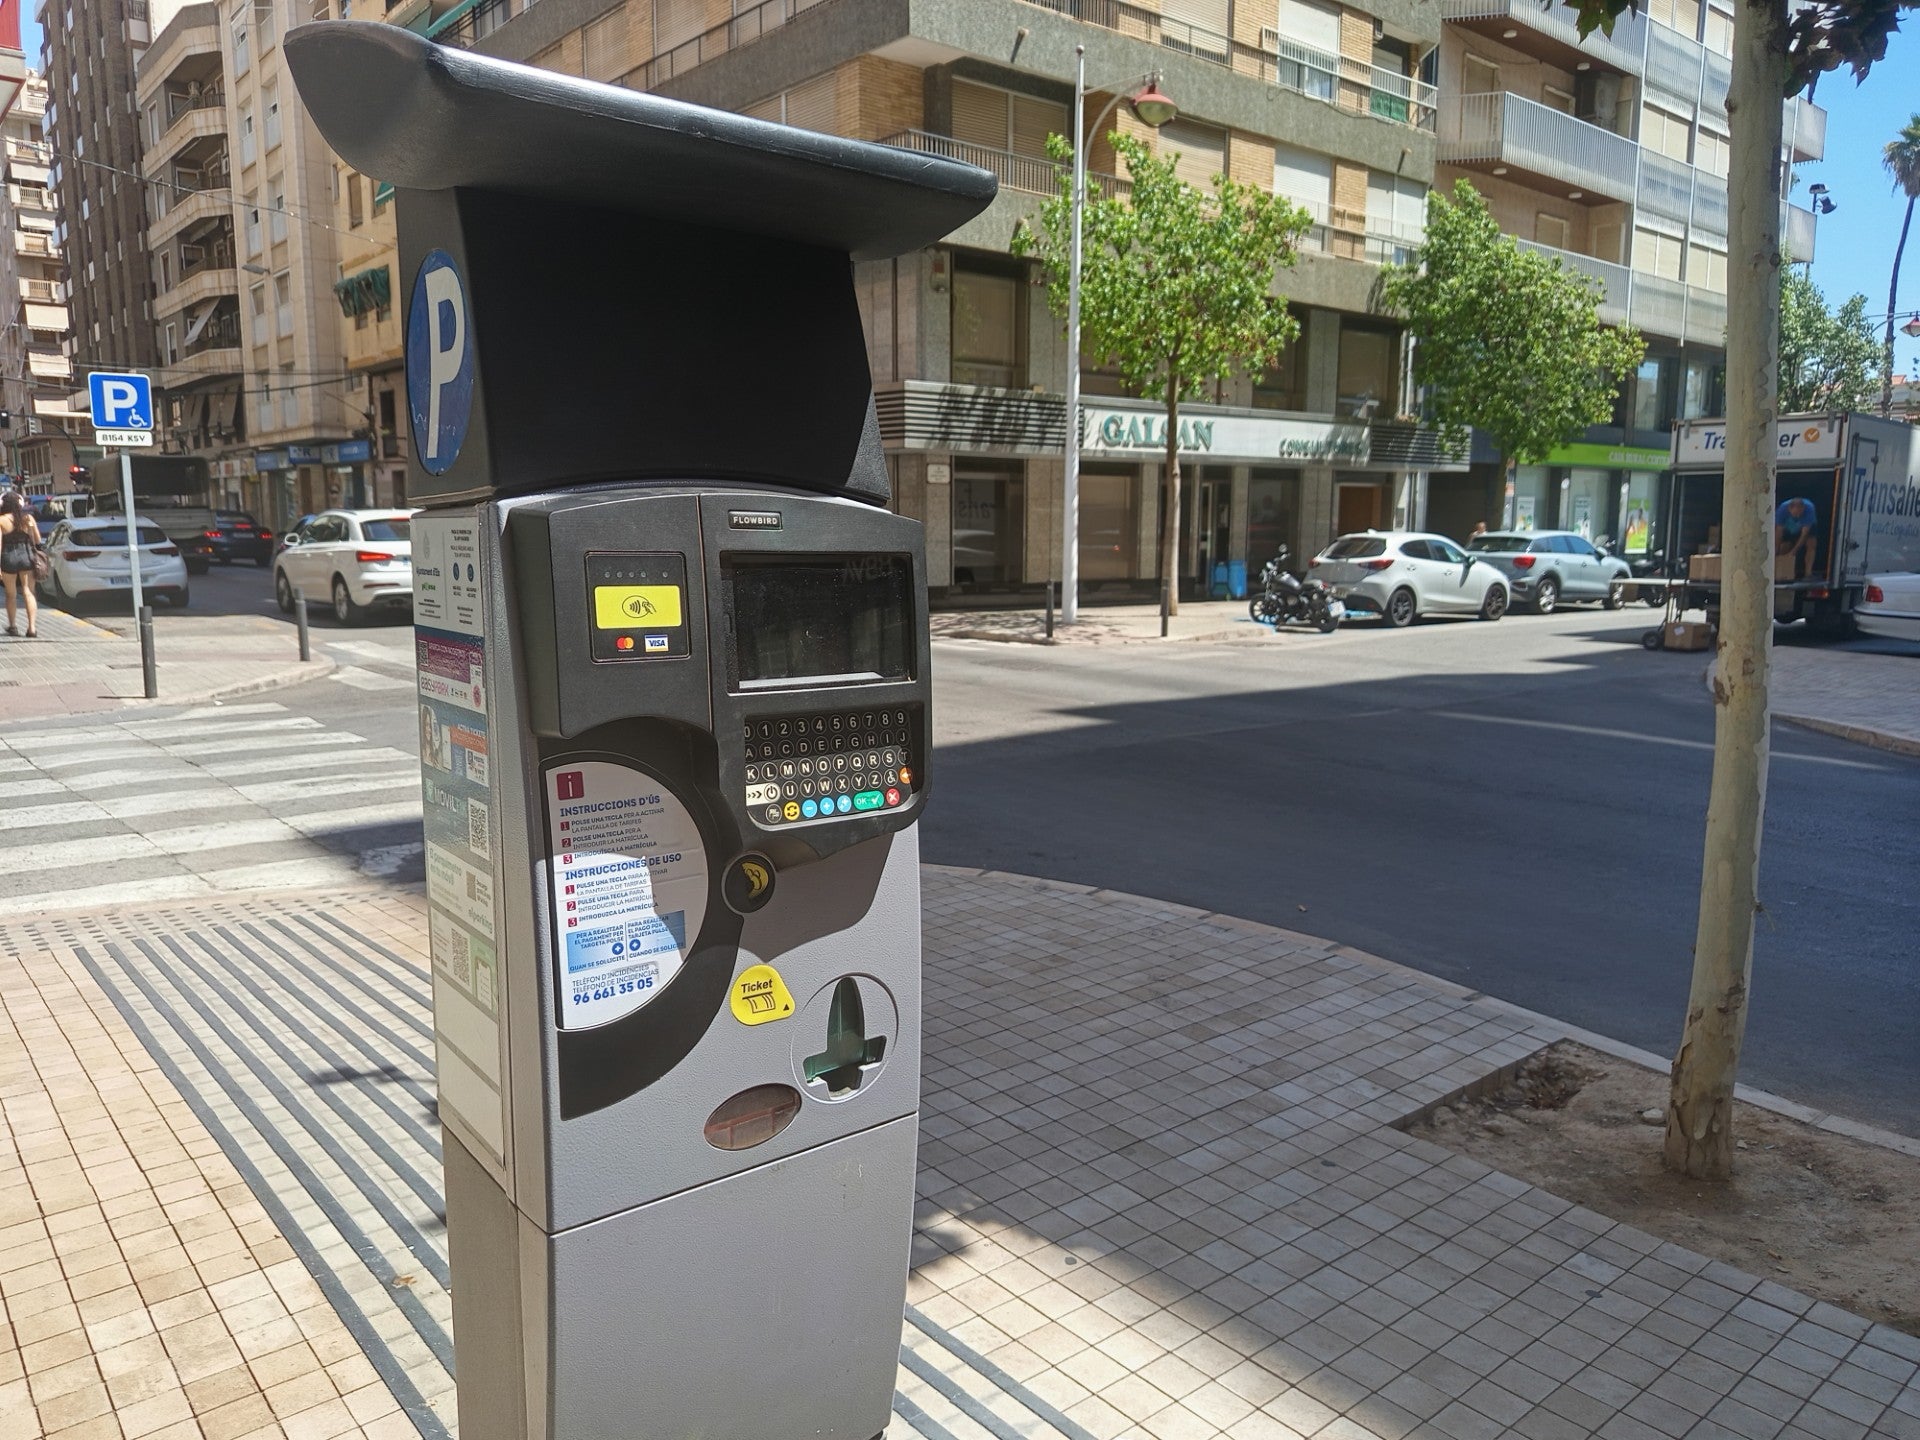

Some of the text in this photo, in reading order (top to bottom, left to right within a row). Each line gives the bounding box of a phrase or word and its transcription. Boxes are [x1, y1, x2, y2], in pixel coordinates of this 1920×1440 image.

[425, 266, 466, 458] P
[102, 380, 138, 422] P
[1704, 432, 1800, 450] Traer
[733, 516, 778, 525] FLOWBIRD
[762, 724, 768, 736] 1
[780, 724, 787, 734] 2
[799, 722, 805, 732] 3
[816, 720, 823, 730] 4
[834, 718, 840, 729] 5
[850, 717, 856, 727] 6
[866, 716, 872, 726] 7
[882, 714, 889, 724] 8
[897, 713, 904, 723] 9
[764, 746, 771, 755] B
[782, 744, 789, 754] C
[800, 742, 807, 752] D
[818, 741, 825, 750] E
[836, 739, 841, 748] F
[852, 737, 859, 747] G
[868, 736, 875, 745] H
[901, 732, 906, 741] J
[747, 768, 755, 779] K
[766, 767, 774, 777] L
[783, 765, 793, 775] M
[802, 763, 810, 772] N
[819, 761, 828, 771] O
[837, 758, 844, 768] P
[853, 757, 862, 768] Q
[870, 755, 877, 765] R
[886, 754, 893, 763] S
[786, 774, 878, 796] U V W X Y Z
[560, 794, 660, 816] INSTRUCCIONS D'ÚS
[571, 818, 590, 826] POLSE
[640, 808, 664, 816] ACTIVAR
[580, 823, 610, 832] PANTALLA
[573, 834, 591, 842] POLSE
[592, 832, 605, 840] UNA
[624, 841, 657, 850] MATRÍCULA
[565, 853, 682, 880] INSTRUCCIONES DE USO
[585, 885, 614, 895] PANTALLA
[624, 879, 647, 887] TARIFAS
[578, 897, 596, 905] PULSE
[610, 892, 628, 900] TECLA
[578, 902, 615, 913] INTRODUCIR
[579, 910, 617, 922] INTRODUZCA
[593, 925, 624, 935] REALITZAR
[628, 920, 642, 928] PARA
[581, 940, 605, 949] TARGETA
[582, 934, 612, 944] PAGAMENT
[629, 950, 653, 958] CUANDO
[570, 963, 586, 971] QUAN
[616, 969, 659, 984] INCIDENCIAS
[573, 977, 653, 1005] 96 661 35 05
[741, 978, 773, 993] Ticket
